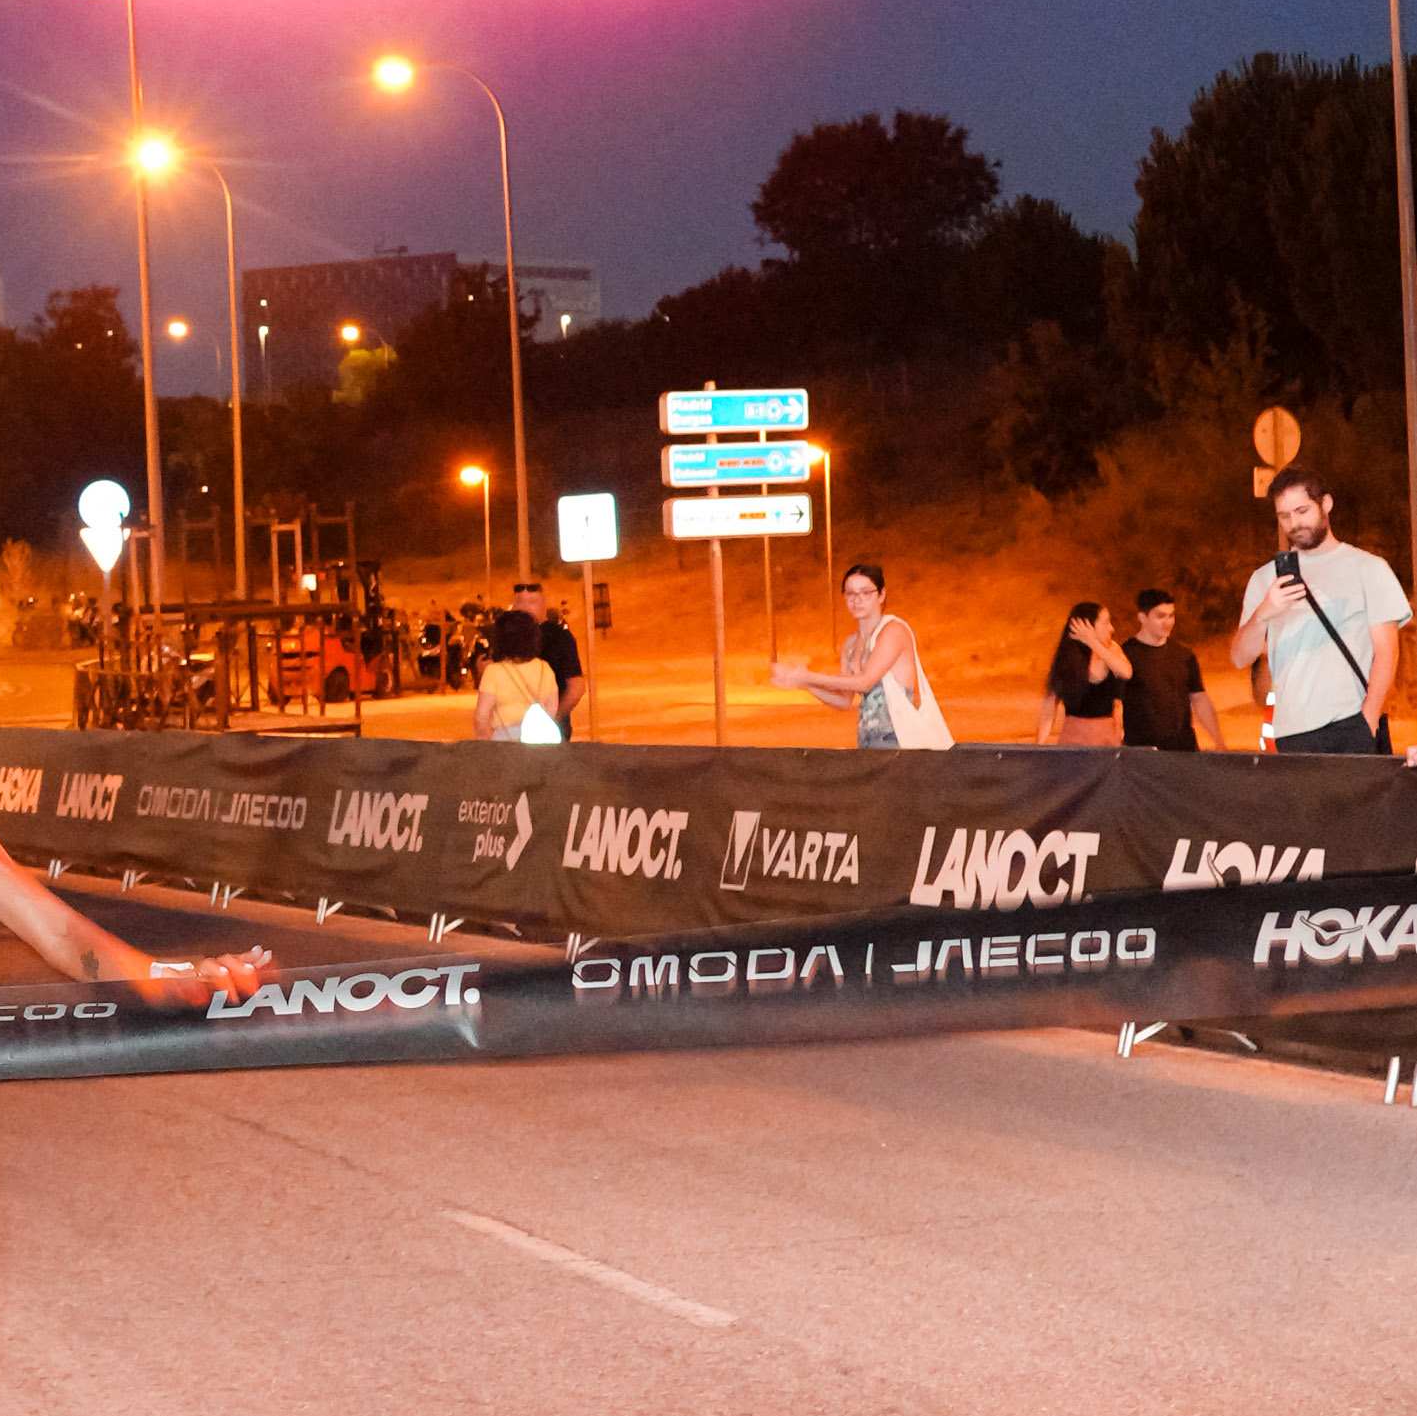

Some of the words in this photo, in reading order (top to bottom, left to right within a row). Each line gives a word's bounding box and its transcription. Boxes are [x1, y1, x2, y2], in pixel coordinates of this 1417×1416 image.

[136, 784, 211, 822] OMODA
[221, 792, 307, 830] JAECOO
[458, 796, 513, 827] exterior
[472, 830, 506, 864] plus
[760, 827, 860, 885] VARTA
[571, 944, 845, 989] OMODA
[891, 927, 1157, 974] JAECOO
